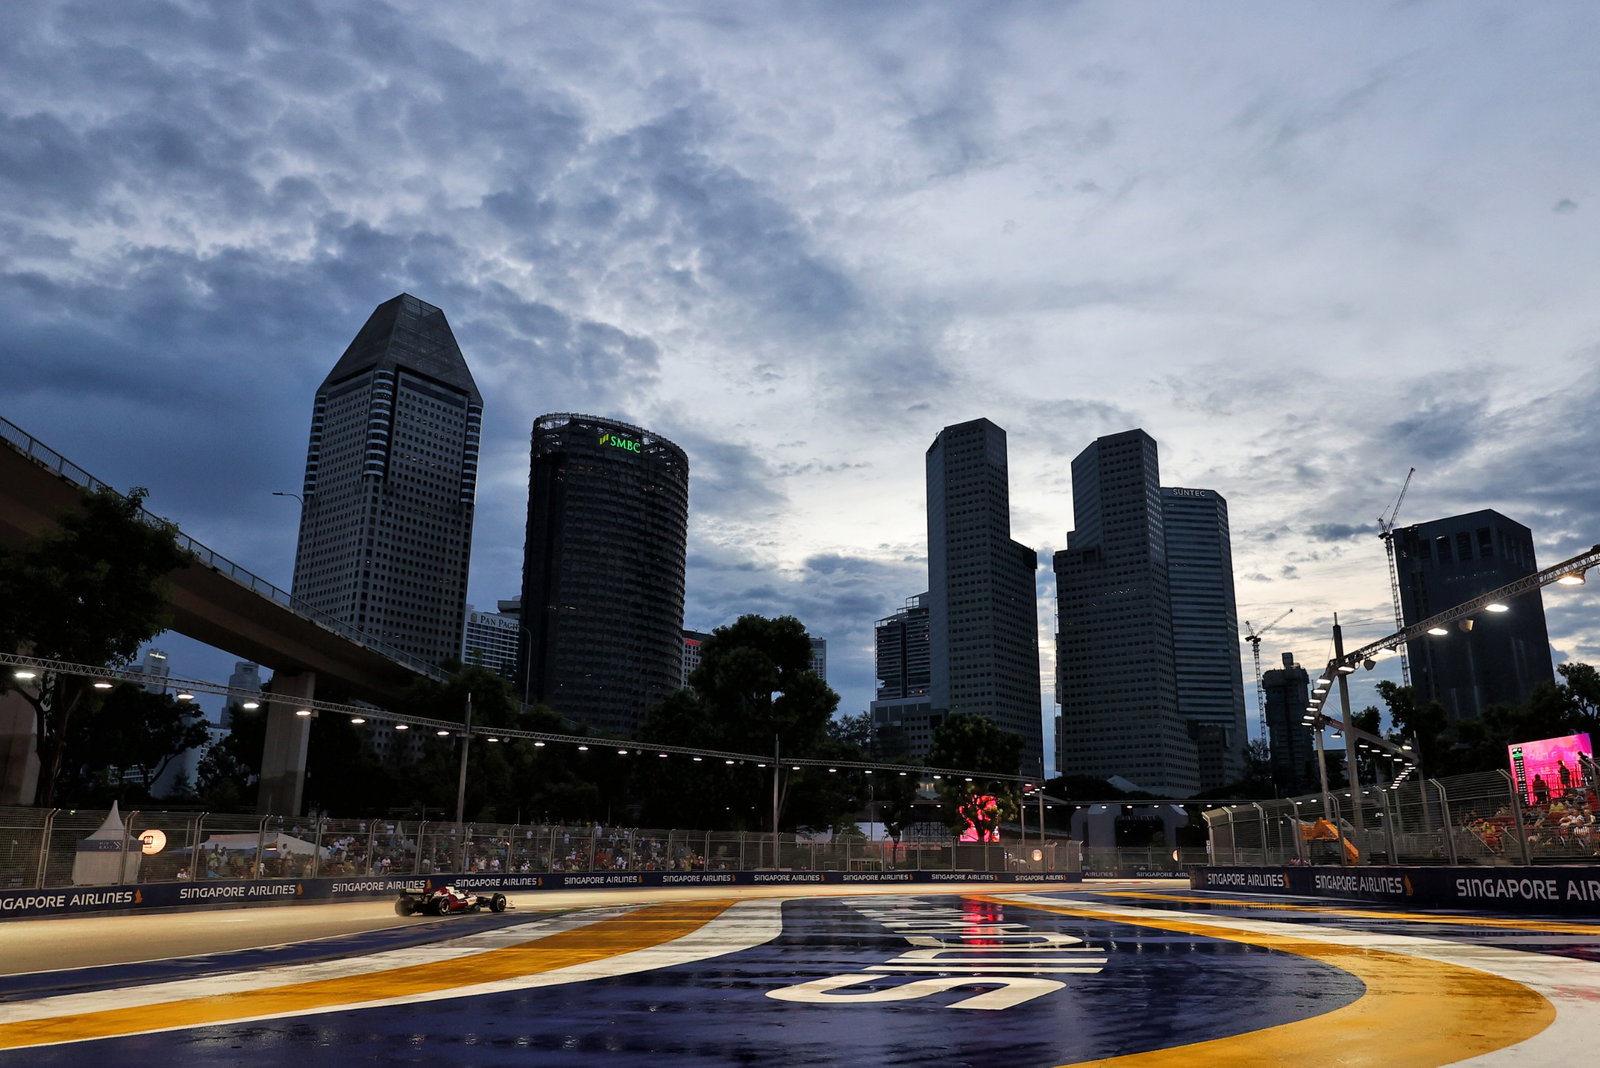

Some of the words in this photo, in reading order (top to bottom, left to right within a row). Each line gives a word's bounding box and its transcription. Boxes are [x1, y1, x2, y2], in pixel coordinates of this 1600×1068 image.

[609, 435, 641, 454] SMBC
[1172, 488, 1205, 497] SUNTEC
[480, 615, 496, 625] PAN
[454, 879, 501, 887] SINGAPORE
[502, 877, 538, 886] AIRLINES
[563, 877, 605, 885] SINGAPORE
[606, 876, 637, 884] AIRLINES
[662, 874, 701, 883] SINGAPORE
[702, 874, 732, 883] AIRLINES
[880, 873, 909, 881] AIRLINES
[931, 873, 966, 881] SINGAPORE
[967, 873, 994, 881] AIRLINES
[1207, 873, 1246, 886] SINGAPORE
[1247, 874, 1285, 888] AIRLINES
[331, 881, 385, 893] SINGAPORE
[386, 880, 426, 891] AIRLINES
[1314, 875, 1358, 891] SINGAPORE
[1359, 876, 1404, 894] AIRLINES
[1455, 878, 1560, 900] SINGAPORE
[179, 886, 246, 900] SINGAPORE
[247, 884, 296, 896] AIRLINES
[0, 895, 66, 911] GAPORE
[69, 891, 133, 906] AIRLINES
